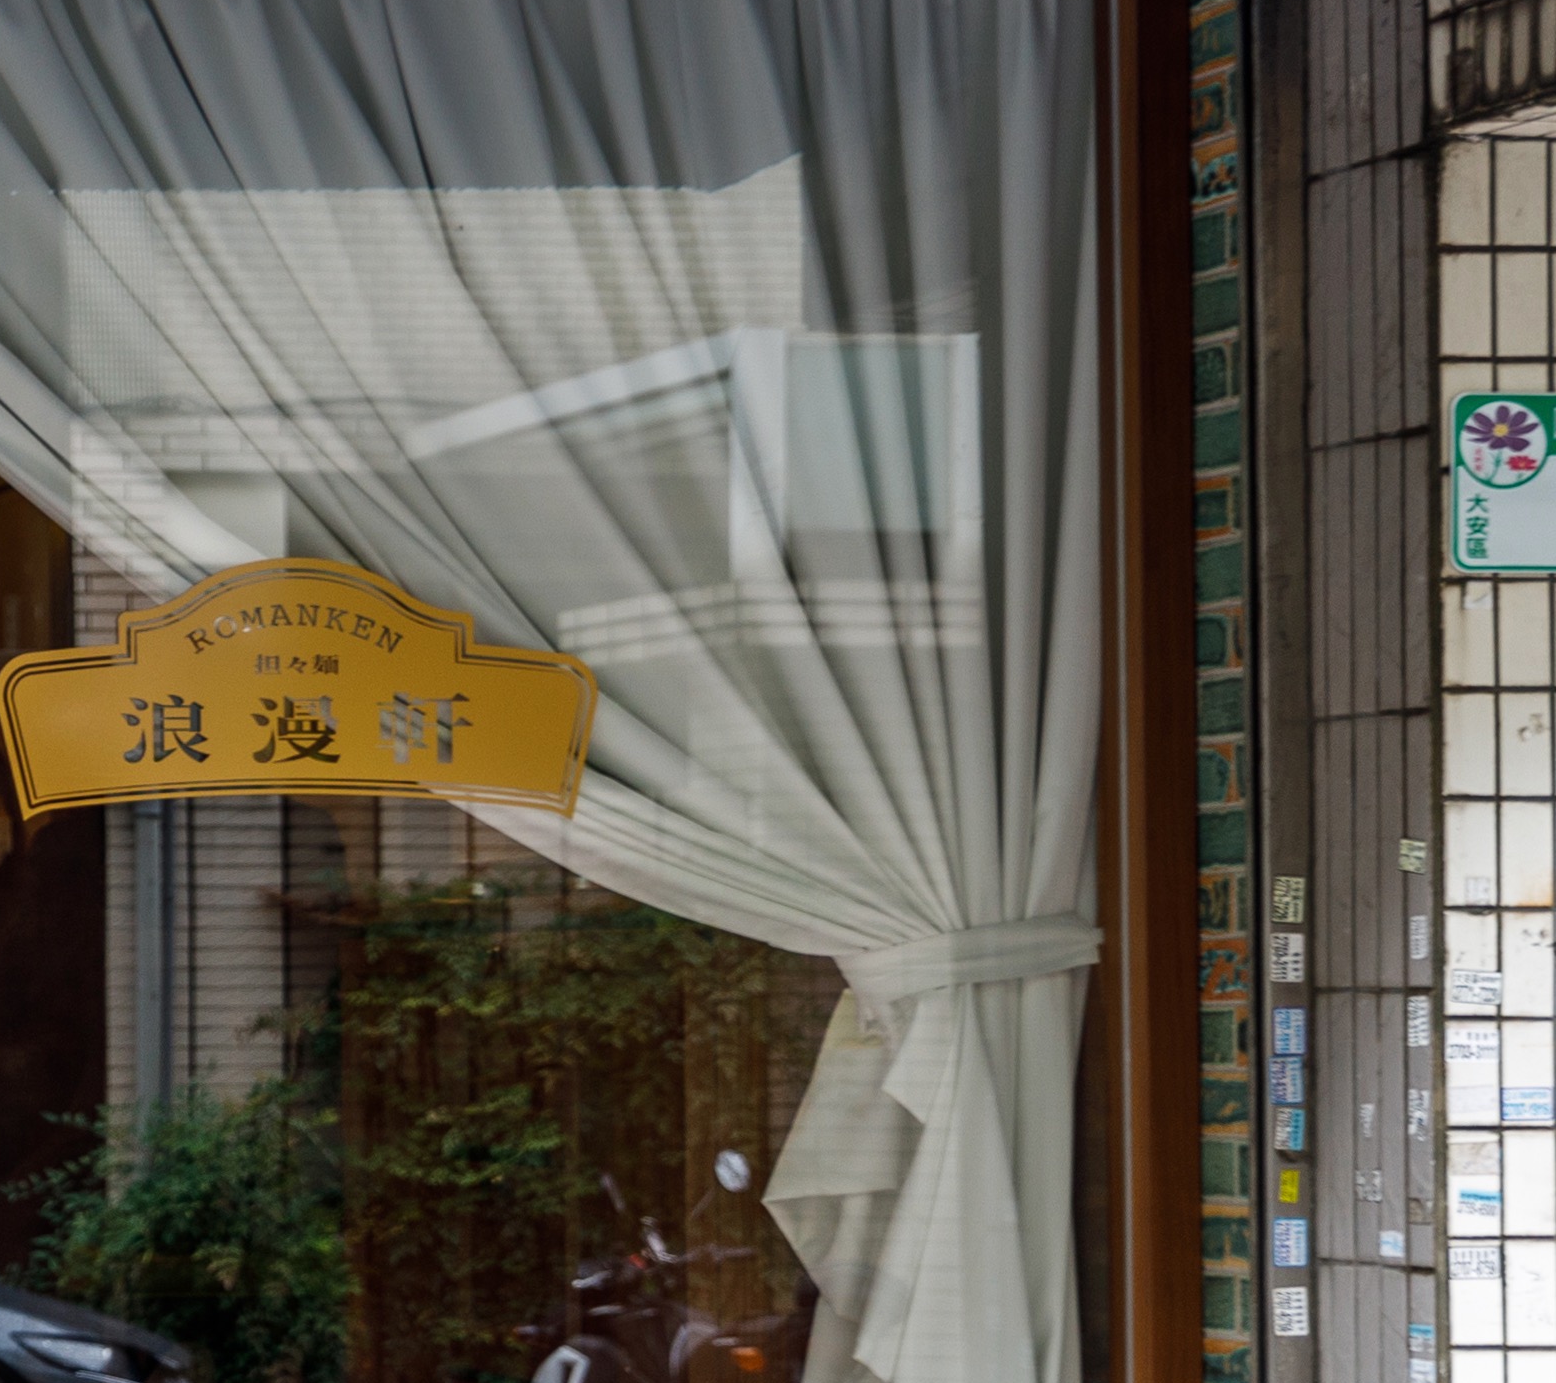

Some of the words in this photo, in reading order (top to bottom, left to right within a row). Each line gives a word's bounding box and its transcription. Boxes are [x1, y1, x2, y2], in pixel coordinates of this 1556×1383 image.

[1466, 493, 1489, 559] 大安區
[185, 603, 406, 655] ROMANKEN
[121, 691, 473, 765] 浪漫軒
